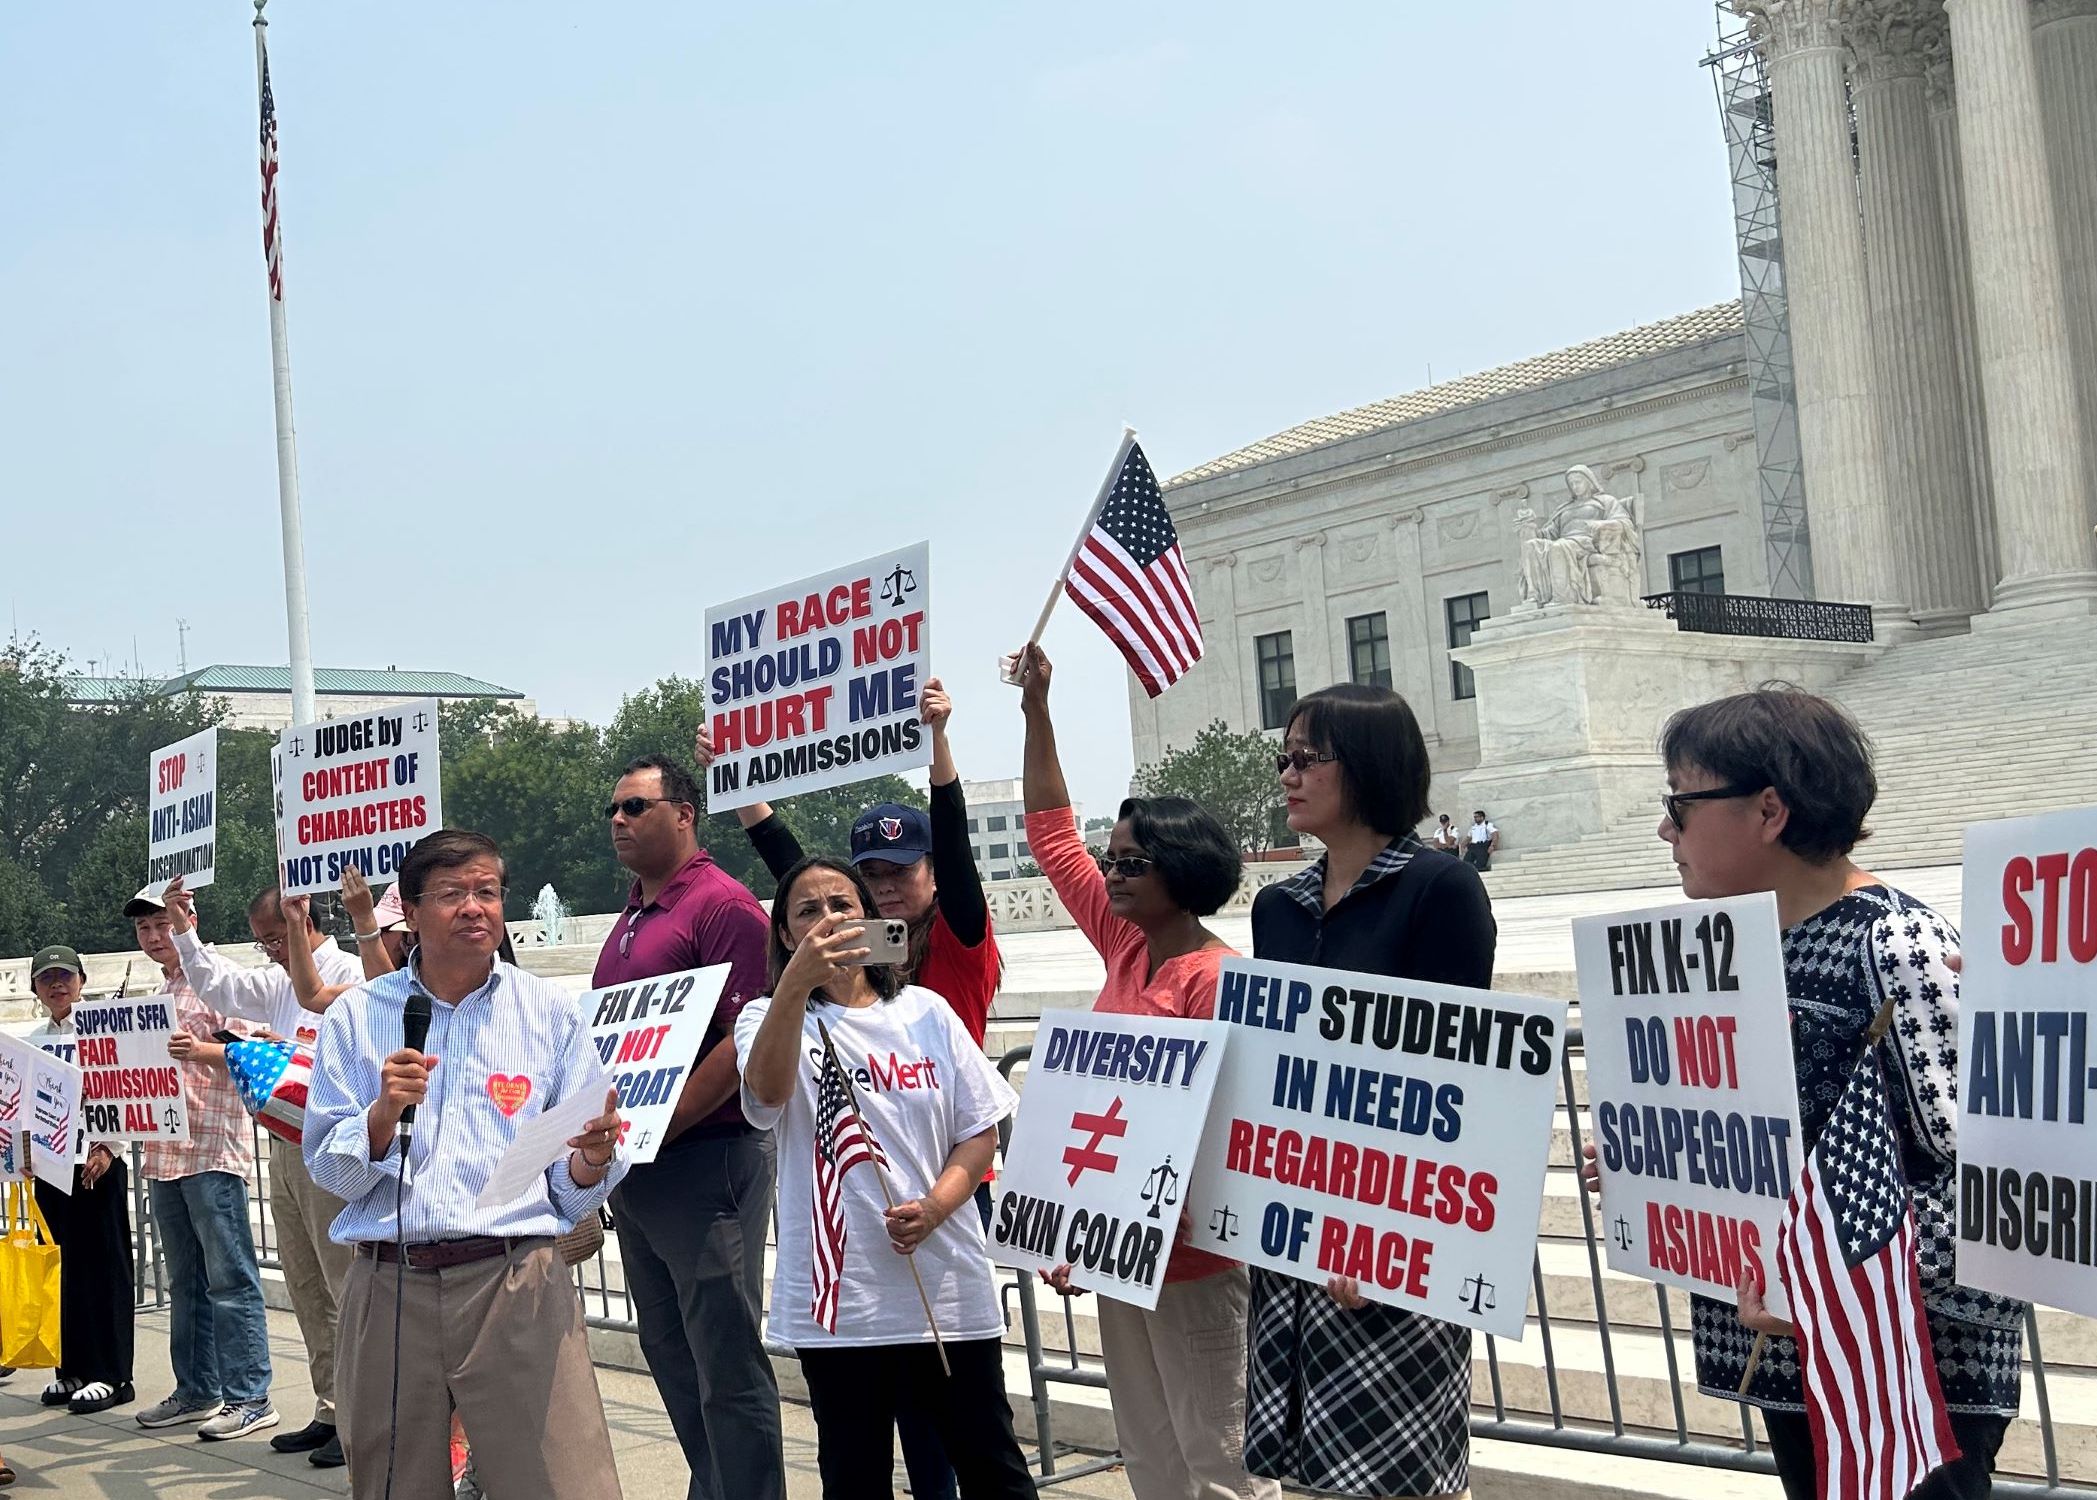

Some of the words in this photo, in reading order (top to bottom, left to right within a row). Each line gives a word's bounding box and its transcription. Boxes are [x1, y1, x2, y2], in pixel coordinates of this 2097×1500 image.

[712, 609, 766, 660] MY
[777, 577, 872, 641] RACE
[712, 637, 841, 705] SHOULD
[853, 611, 924, 668] NOT
[314, 719, 374, 758] JUDGE
[378, 716, 403, 747] by
[713, 685, 833, 756] HURT
[849, 663, 917, 723] ME
[158, 753, 186, 794] STOP
[303, 758, 389, 802] CONTENT
[394, 753, 418, 785] OF
[713, 762, 739, 794] IN
[746, 718, 921, 787] ADMISSIONS
[298, 796, 426, 845] CHARACTERS
[150, 842, 213, 883] DISCRIMINATION
[287, 855, 323, 887] NOT
[328, 847, 373, 881] SKIN
[2002, 846, 2097, 966] STO
[1607, 921, 1660, 996] FIX
[1660, 912, 1740, 994] K-12
[75, 1006, 133, 1035] SUPPORT
[137, 1003, 169, 1031] SFFA
[592, 987, 637, 1027] FIX
[631, 976, 695, 1020] K-12
[1218, 971, 1312, 1034] HELP
[1319, 985, 1554, 1076] STUDENTS
[78, 1037, 119, 1067] FAIR
[615, 1024, 672, 1065] NOT
[809, 1048, 940, 1093] SeMerit
[1043, 1027, 1207, 1087] DIVERSITY
[1625, 1015, 1671, 1086] DO
[1674, 1015, 1738, 1090] NOT
[83, 1066, 179, 1100] ADMISSIONS
[612, 1065, 685, 1109] GOAT
[1272, 1054, 1318, 1113] IN
[1324, 1064, 1464, 1143] NEEDS
[85, 1104, 121, 1133] FOR
[125, 1103, 158, 1132] ALL
[1600, 1100, 1791, 1200] SCAPEGOAT
[1226, 1118, 1498, 1233] REGARDLESS
[995, 1190, 1065, 1259] SKIN
[1065, 1208, 1164, 1286] COLOR
[1961, 1162, 2097, 1267] DISCRI
[1260, 1201, 1313, 1263] OF
[1317, 1215, 1434, 1299] RACE
[1646, 1201, 1766, 1297] ASIANS
